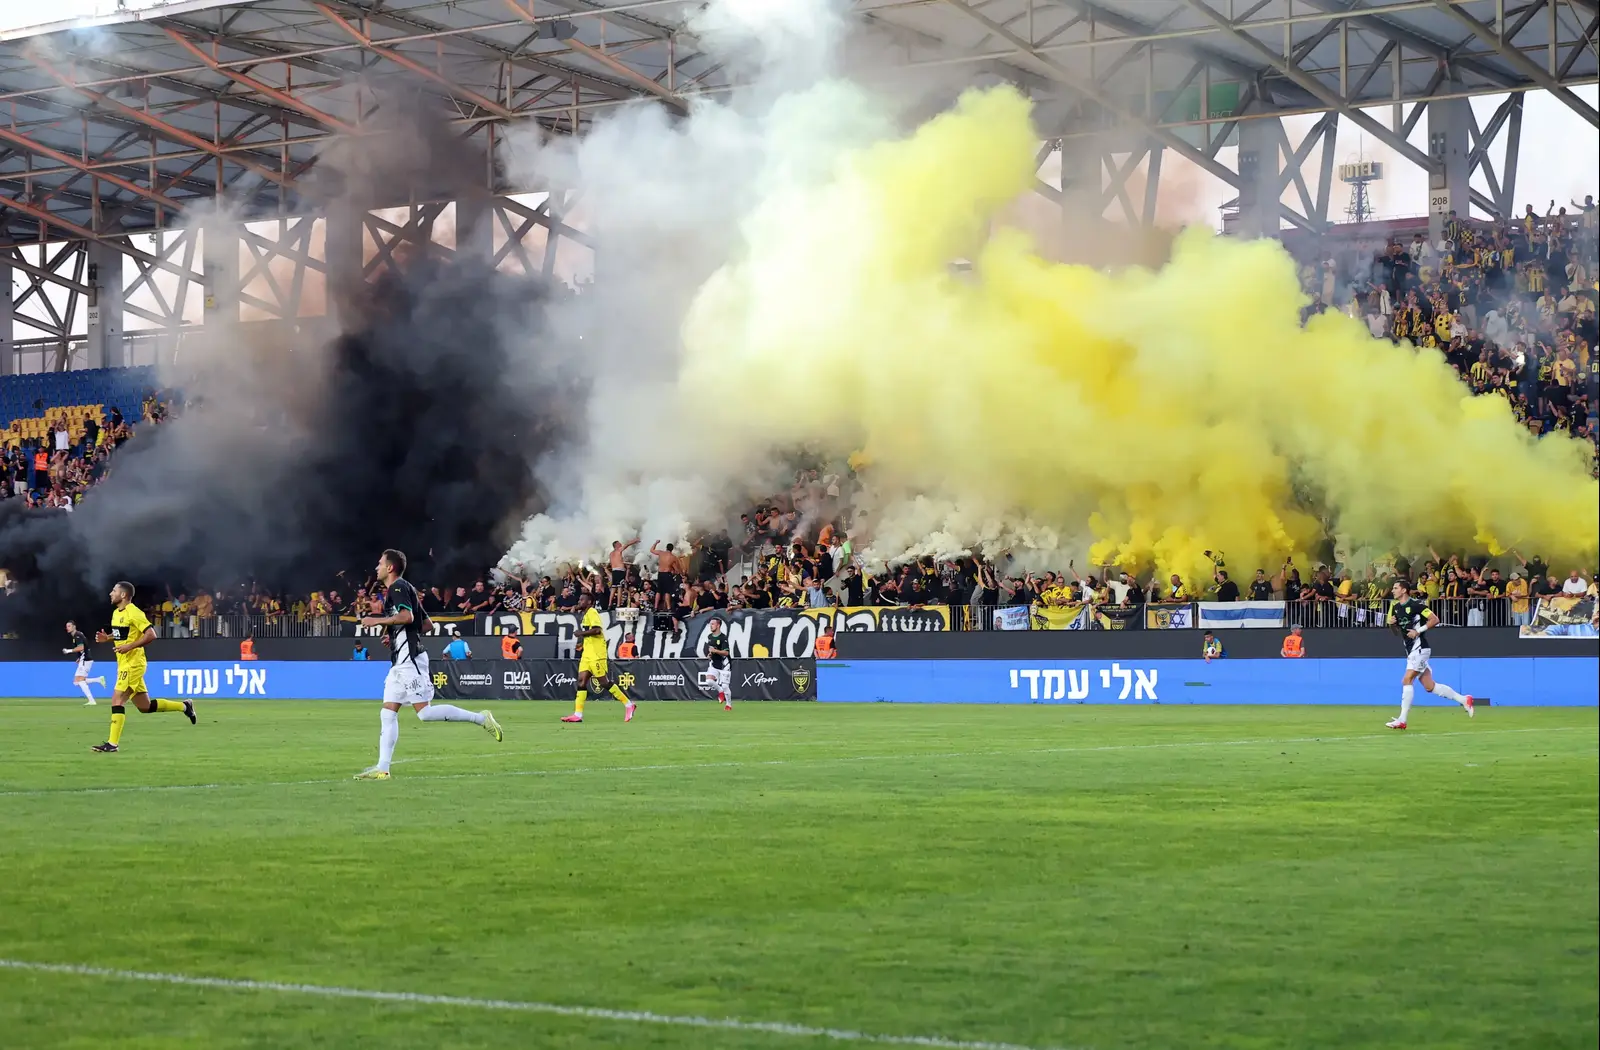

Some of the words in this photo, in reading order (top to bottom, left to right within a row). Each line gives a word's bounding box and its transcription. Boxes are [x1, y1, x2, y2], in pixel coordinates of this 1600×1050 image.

[1339, 162, 1376, 181] HOTEL
[1432, 196, 1448, 206] 208
[596, 662, 601, 671] 9
[163, 669, 219, 694] עמדי
[225, 663, 266, 694] אלי
[503, 671, 531, 685] גשם
[543, 673, 557, 688] X
[554, 672, 577, 687] Group
[741, 672, 756, 688] X
[754, 672, 779, 687] Group
[1009, 669, 1089, 700] עמדי
[1099, 663, 1158, 700] אלי
